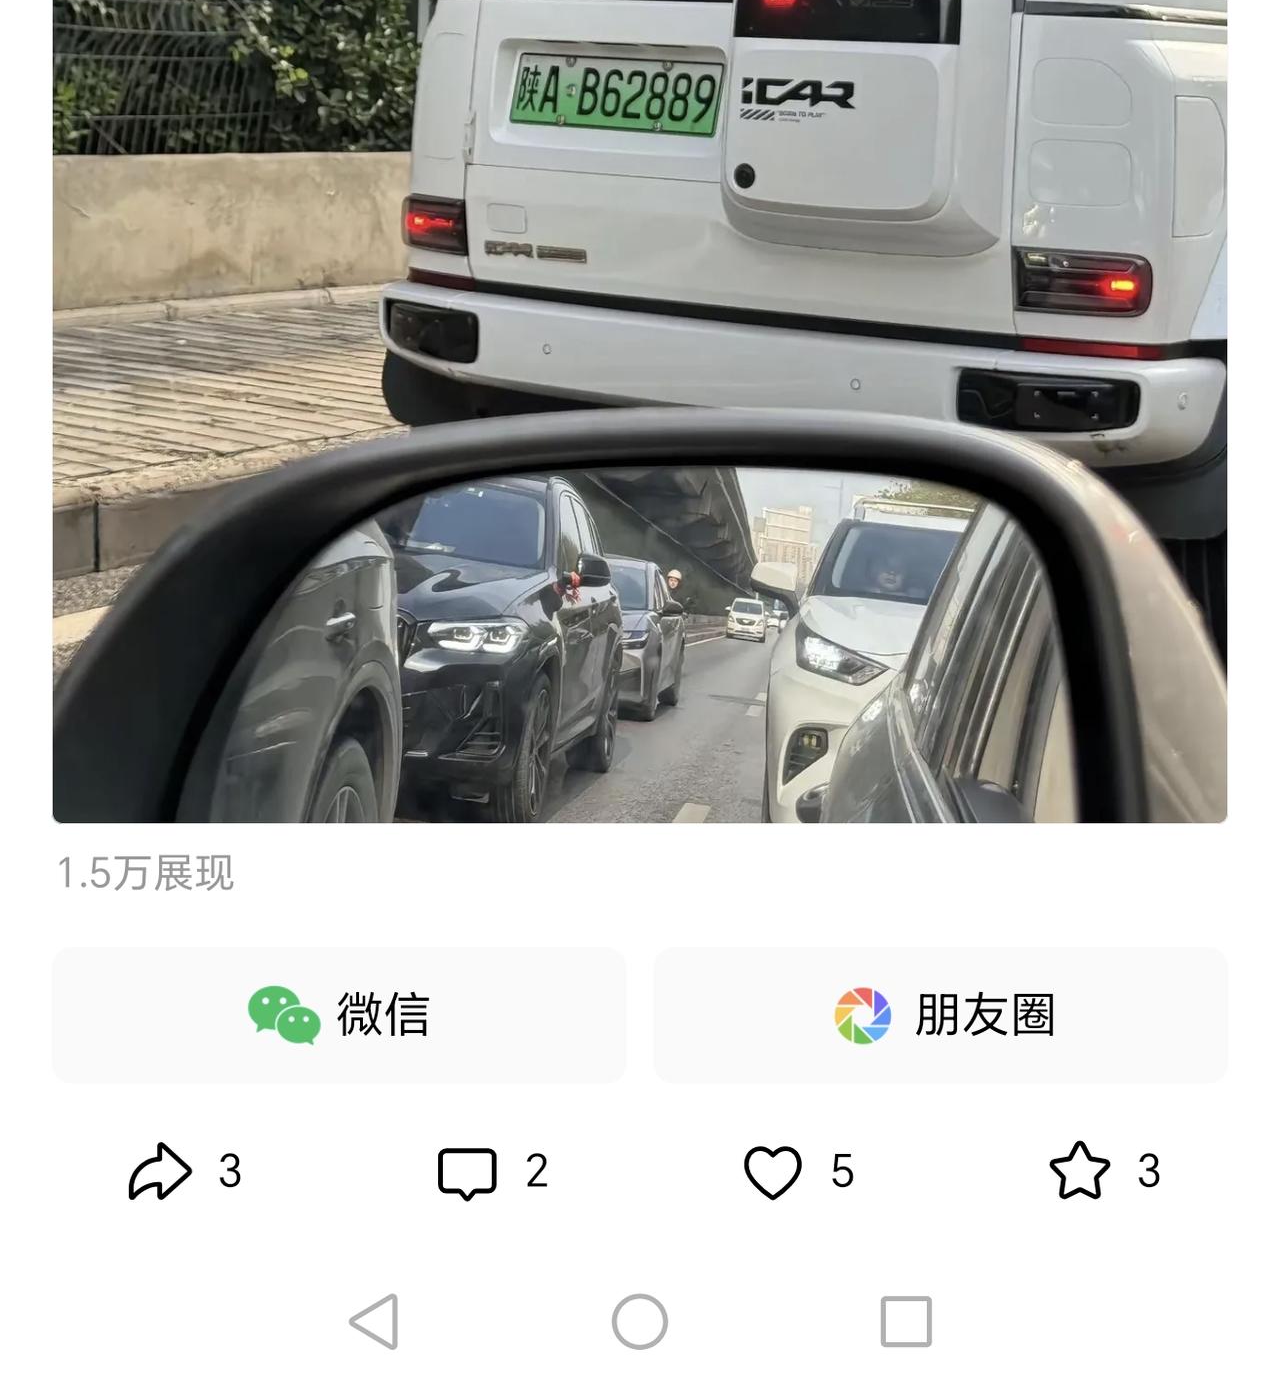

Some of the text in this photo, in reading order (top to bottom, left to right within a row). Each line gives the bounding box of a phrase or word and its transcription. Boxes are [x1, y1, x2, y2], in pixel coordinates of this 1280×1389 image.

[58, 854, 235, 893] 1.5万展现
[336, 991, 430, 1037] 微信
[915, 991, 1055, 1037] 朋友圈
[218, 1152, 242, 1189] 3
[526, 1152, 548, 1188] 2
[831, 1153, 855, 1189] 5
[1137, 1152, 1161, 1189] 3
